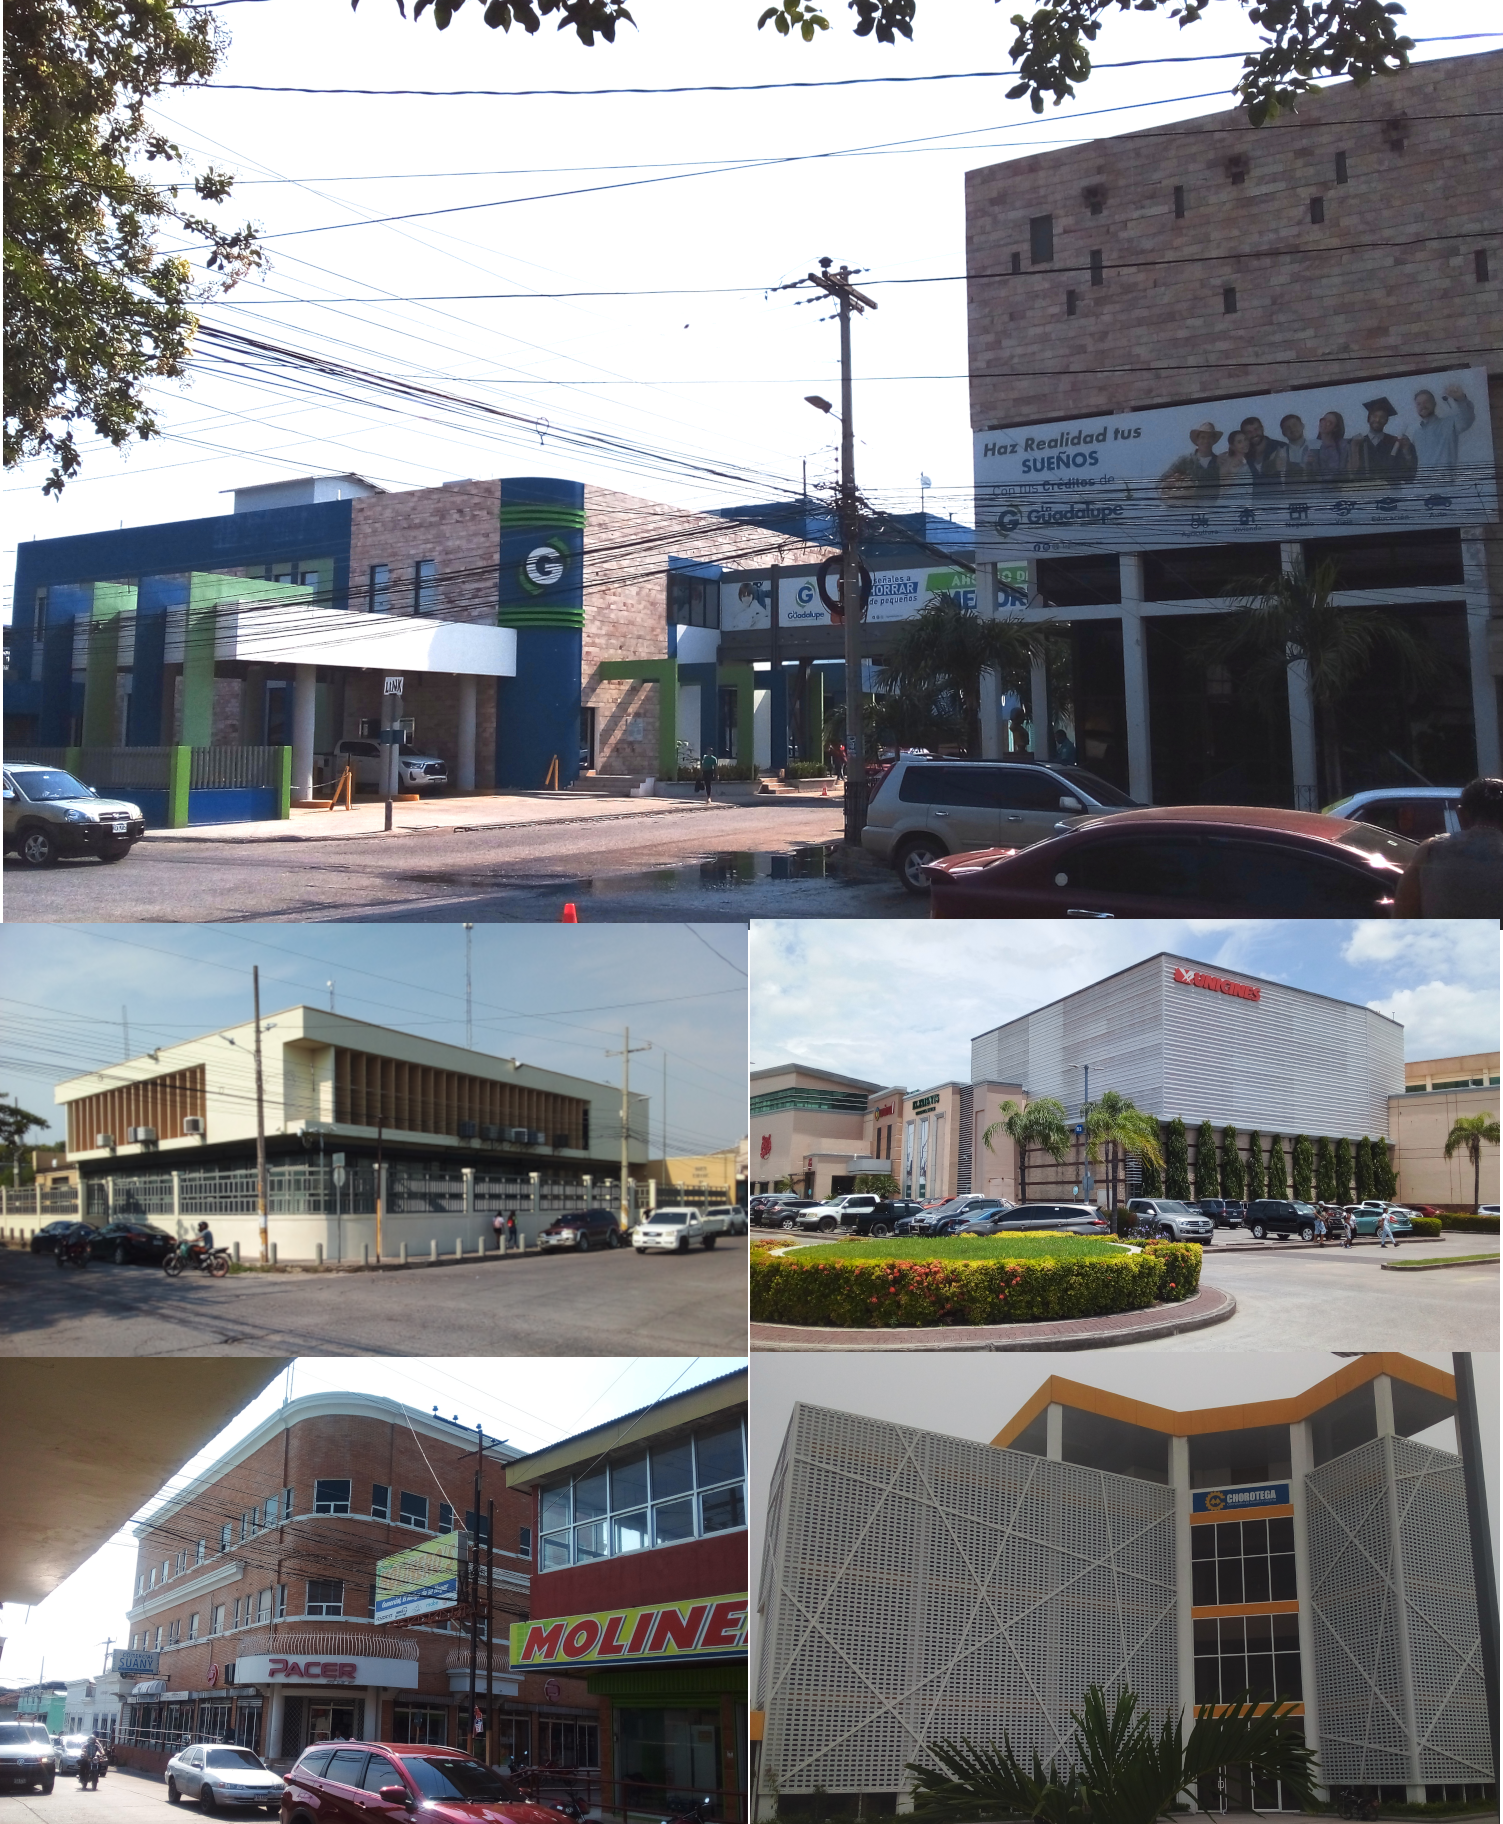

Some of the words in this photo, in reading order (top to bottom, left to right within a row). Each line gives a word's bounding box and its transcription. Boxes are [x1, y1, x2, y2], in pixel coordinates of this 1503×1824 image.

[983, 442, 1019, 458] Haz
[1024, 426, 1108, 453] Realidad
[1113, 426, 1142, 441] tus
[1021, 451, 1099, 474] SUEÑOS
[1042, 477, 1096, 492] Créditos
[1099, 473, 1115, 486] de
[1027, 502, 1124, 525] Guadalupe
[1233, 524, 1262, 533] Vivienda
[870, 582, 914, 596] HORRAR
[880, 594, 918, 606] pequeños
[1193, 972, 1261, 1002] UNICINES
[1226, 1489, 1277, 1503] CHOROTEGA
[520, 1598, 748, 1663] MOLINE
[118, 1657, 154, 1669] SUANY
[122, 1652, 154, 1660] COMERCIAL
[268, 1658, 357, 1679] PACER
